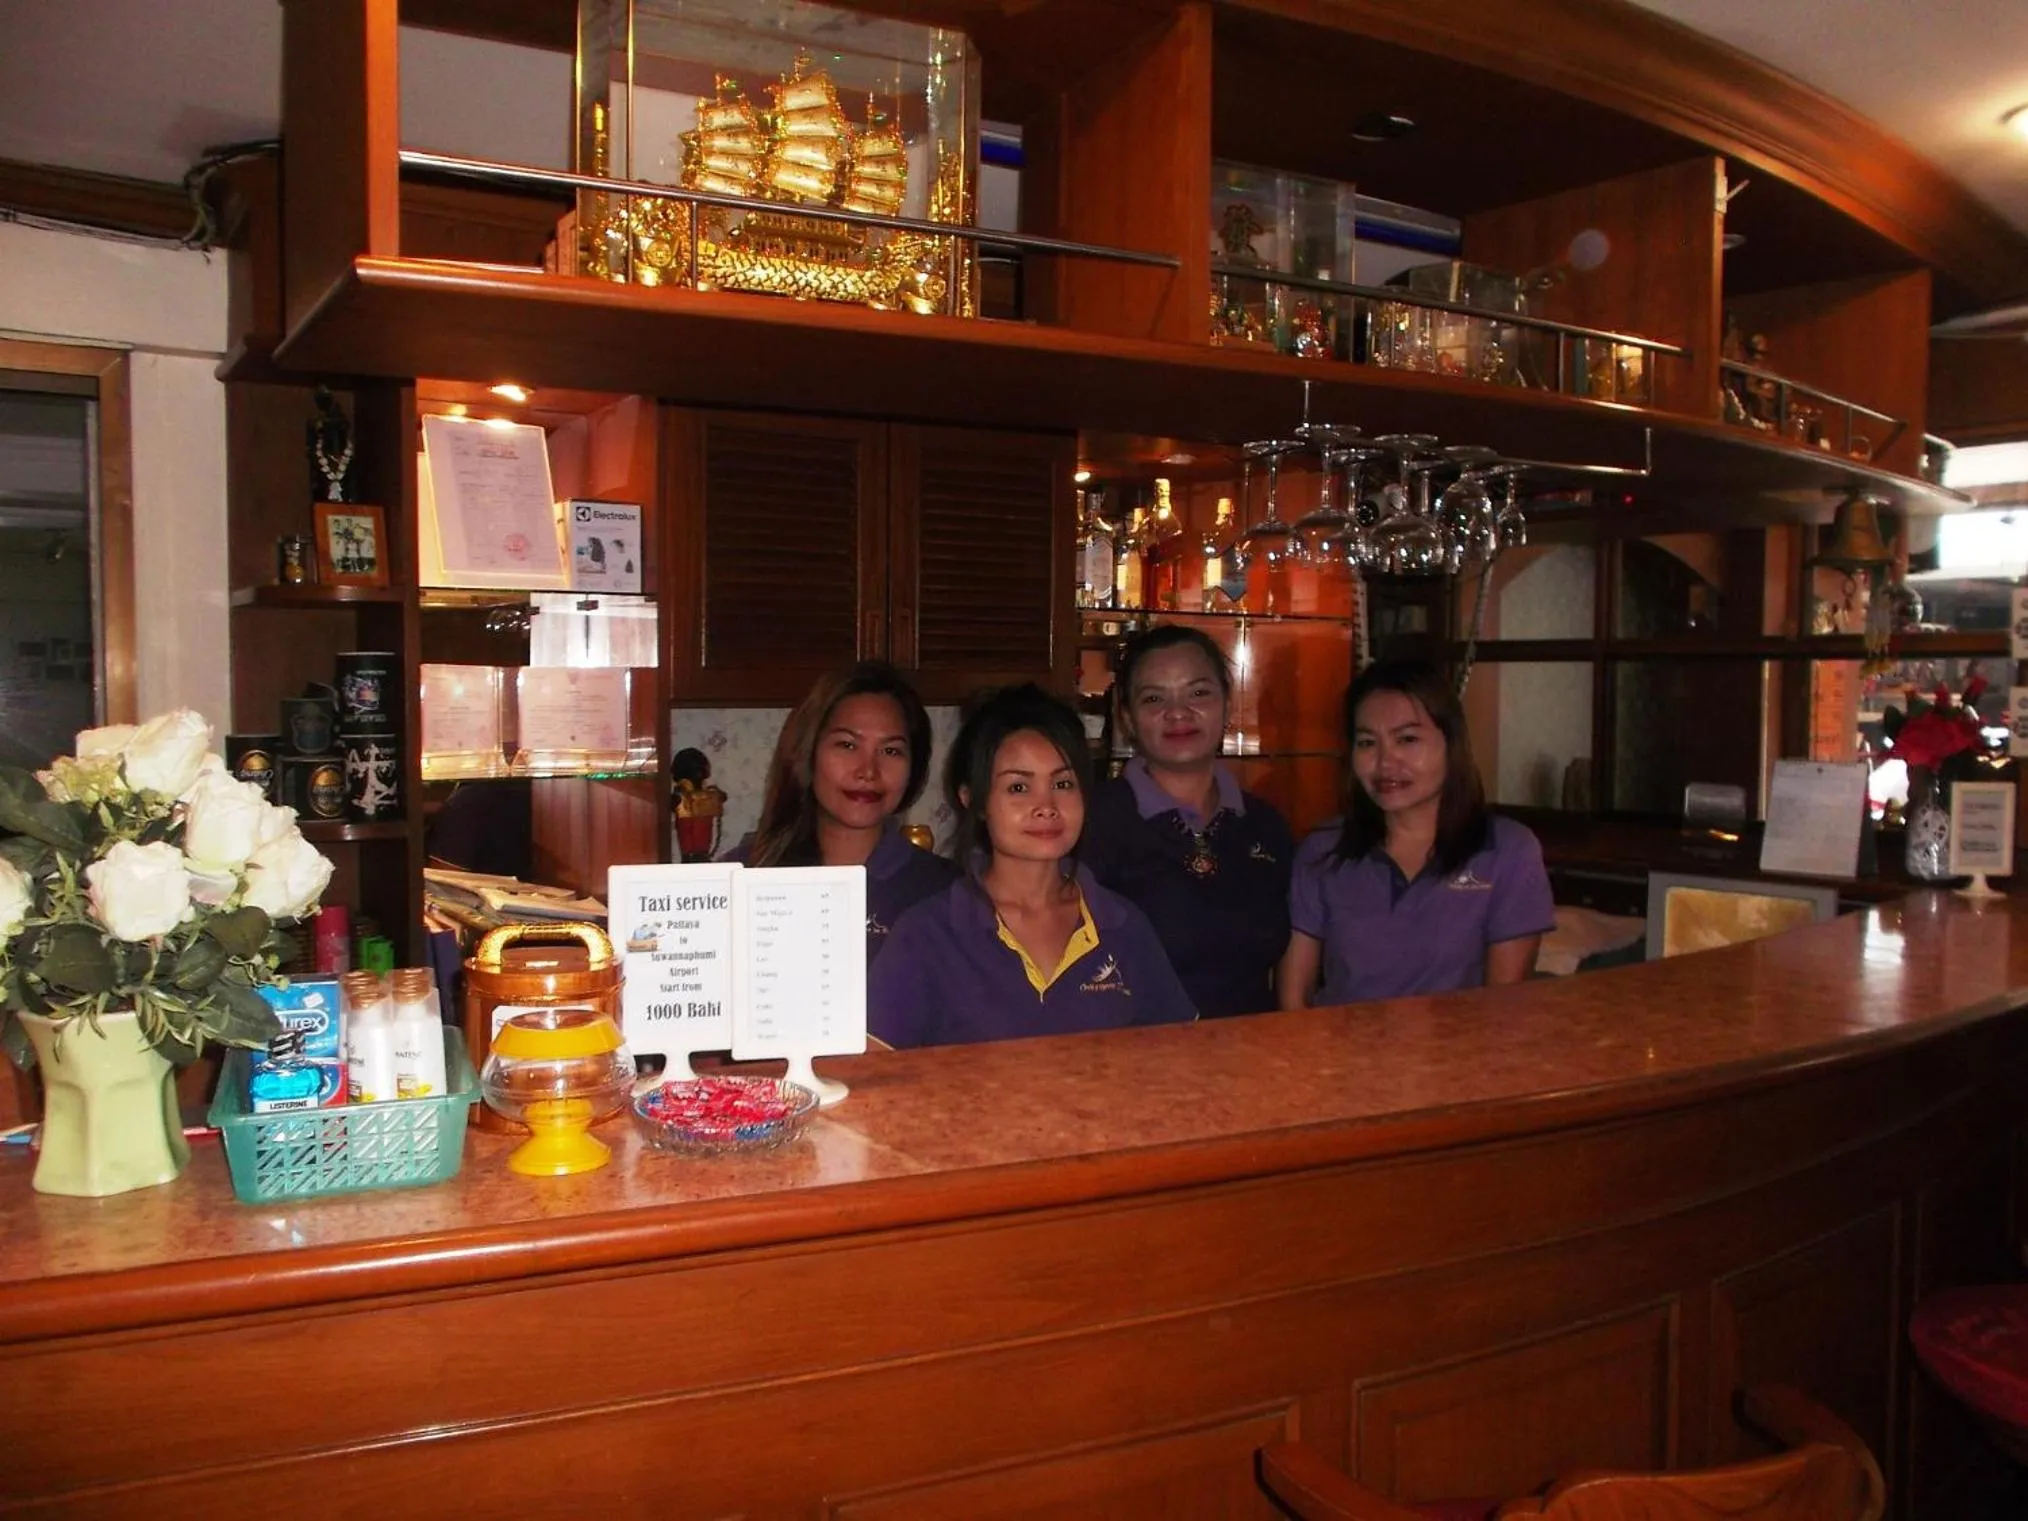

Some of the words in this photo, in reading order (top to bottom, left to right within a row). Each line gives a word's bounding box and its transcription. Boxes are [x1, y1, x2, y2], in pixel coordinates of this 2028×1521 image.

[594, 510, 636, 521] Electrolux
[638, 894, 671, 912] Taxi
[676, 893, 728, 911] service
[666, 920, 700, 930] Pattaya
[669, 967, 699, 977] Airport
[682, 982, 702, 992] from
[646, 1002, 682, 1020] 1000
[269, 1100, 308, 1110] LISTERINE
